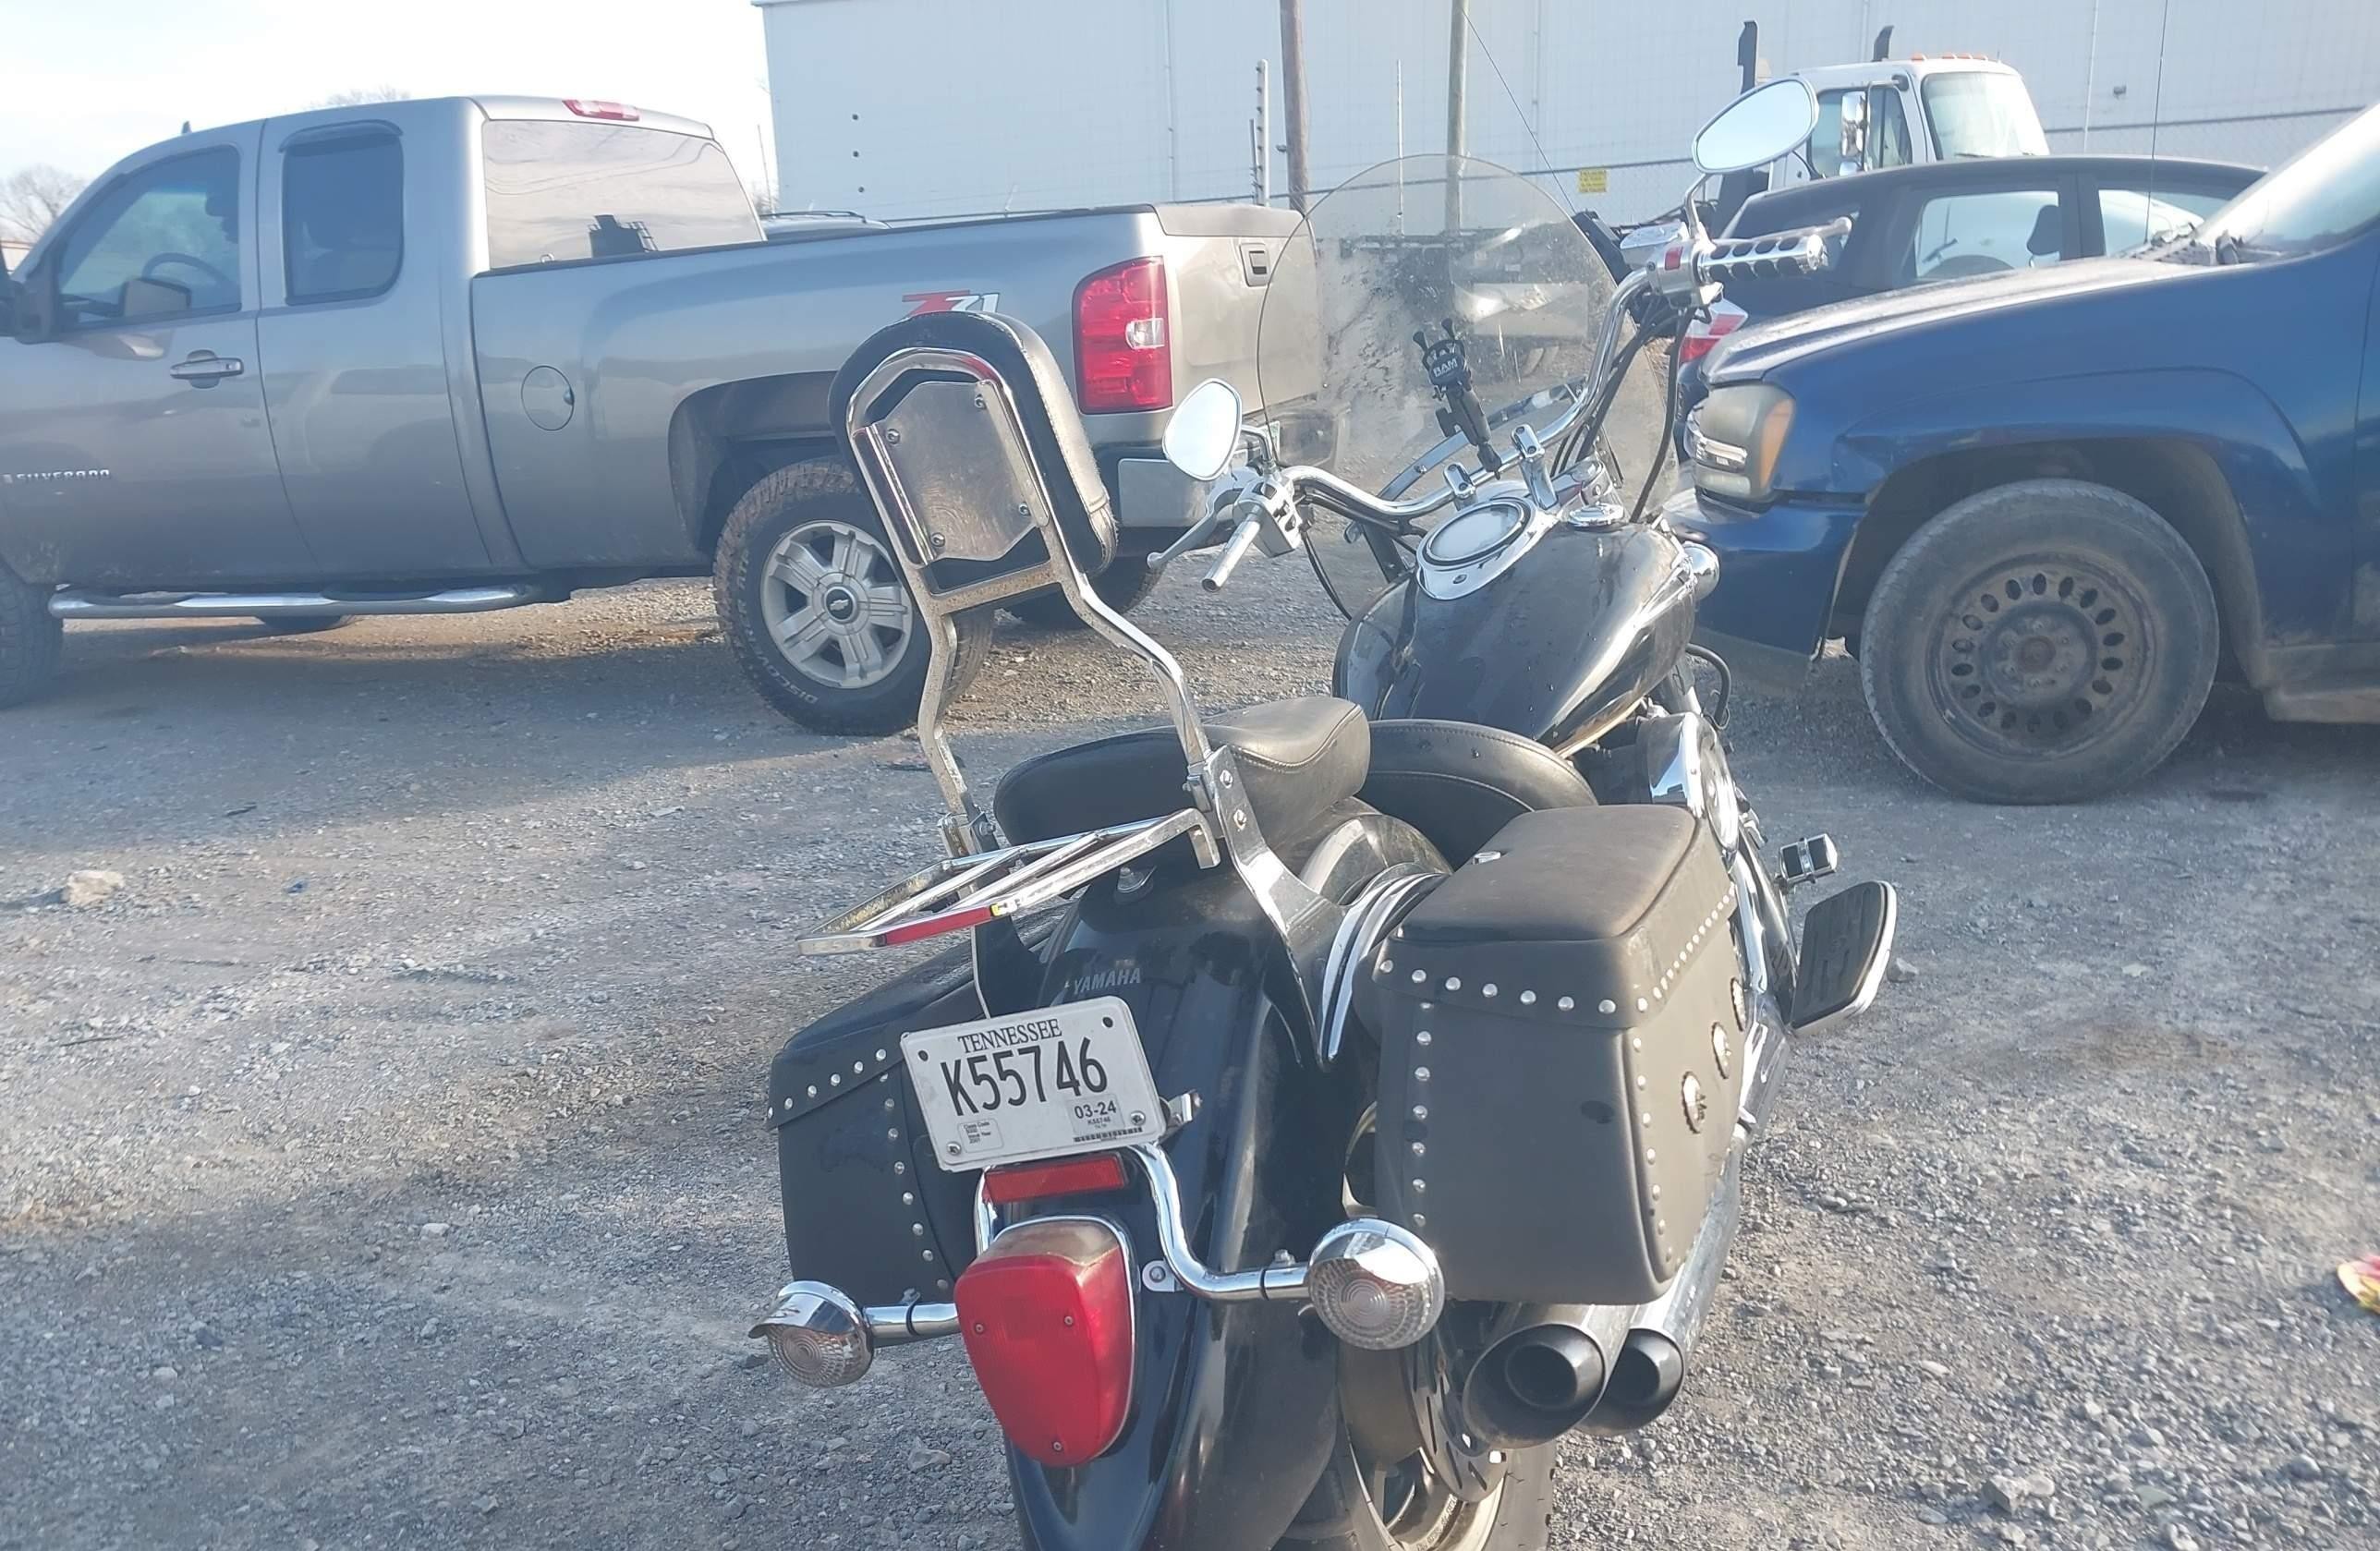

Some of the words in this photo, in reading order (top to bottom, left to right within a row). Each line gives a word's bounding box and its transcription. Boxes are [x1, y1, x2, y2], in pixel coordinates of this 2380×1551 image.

[1074, 968, 1140, 995] YAMAHA
[957, 1018, 1062, 1054] TENNESSEE
[940, 1036, 1109, 1117] K55746
[1074, 1100, 1117, 1119] 03-24
